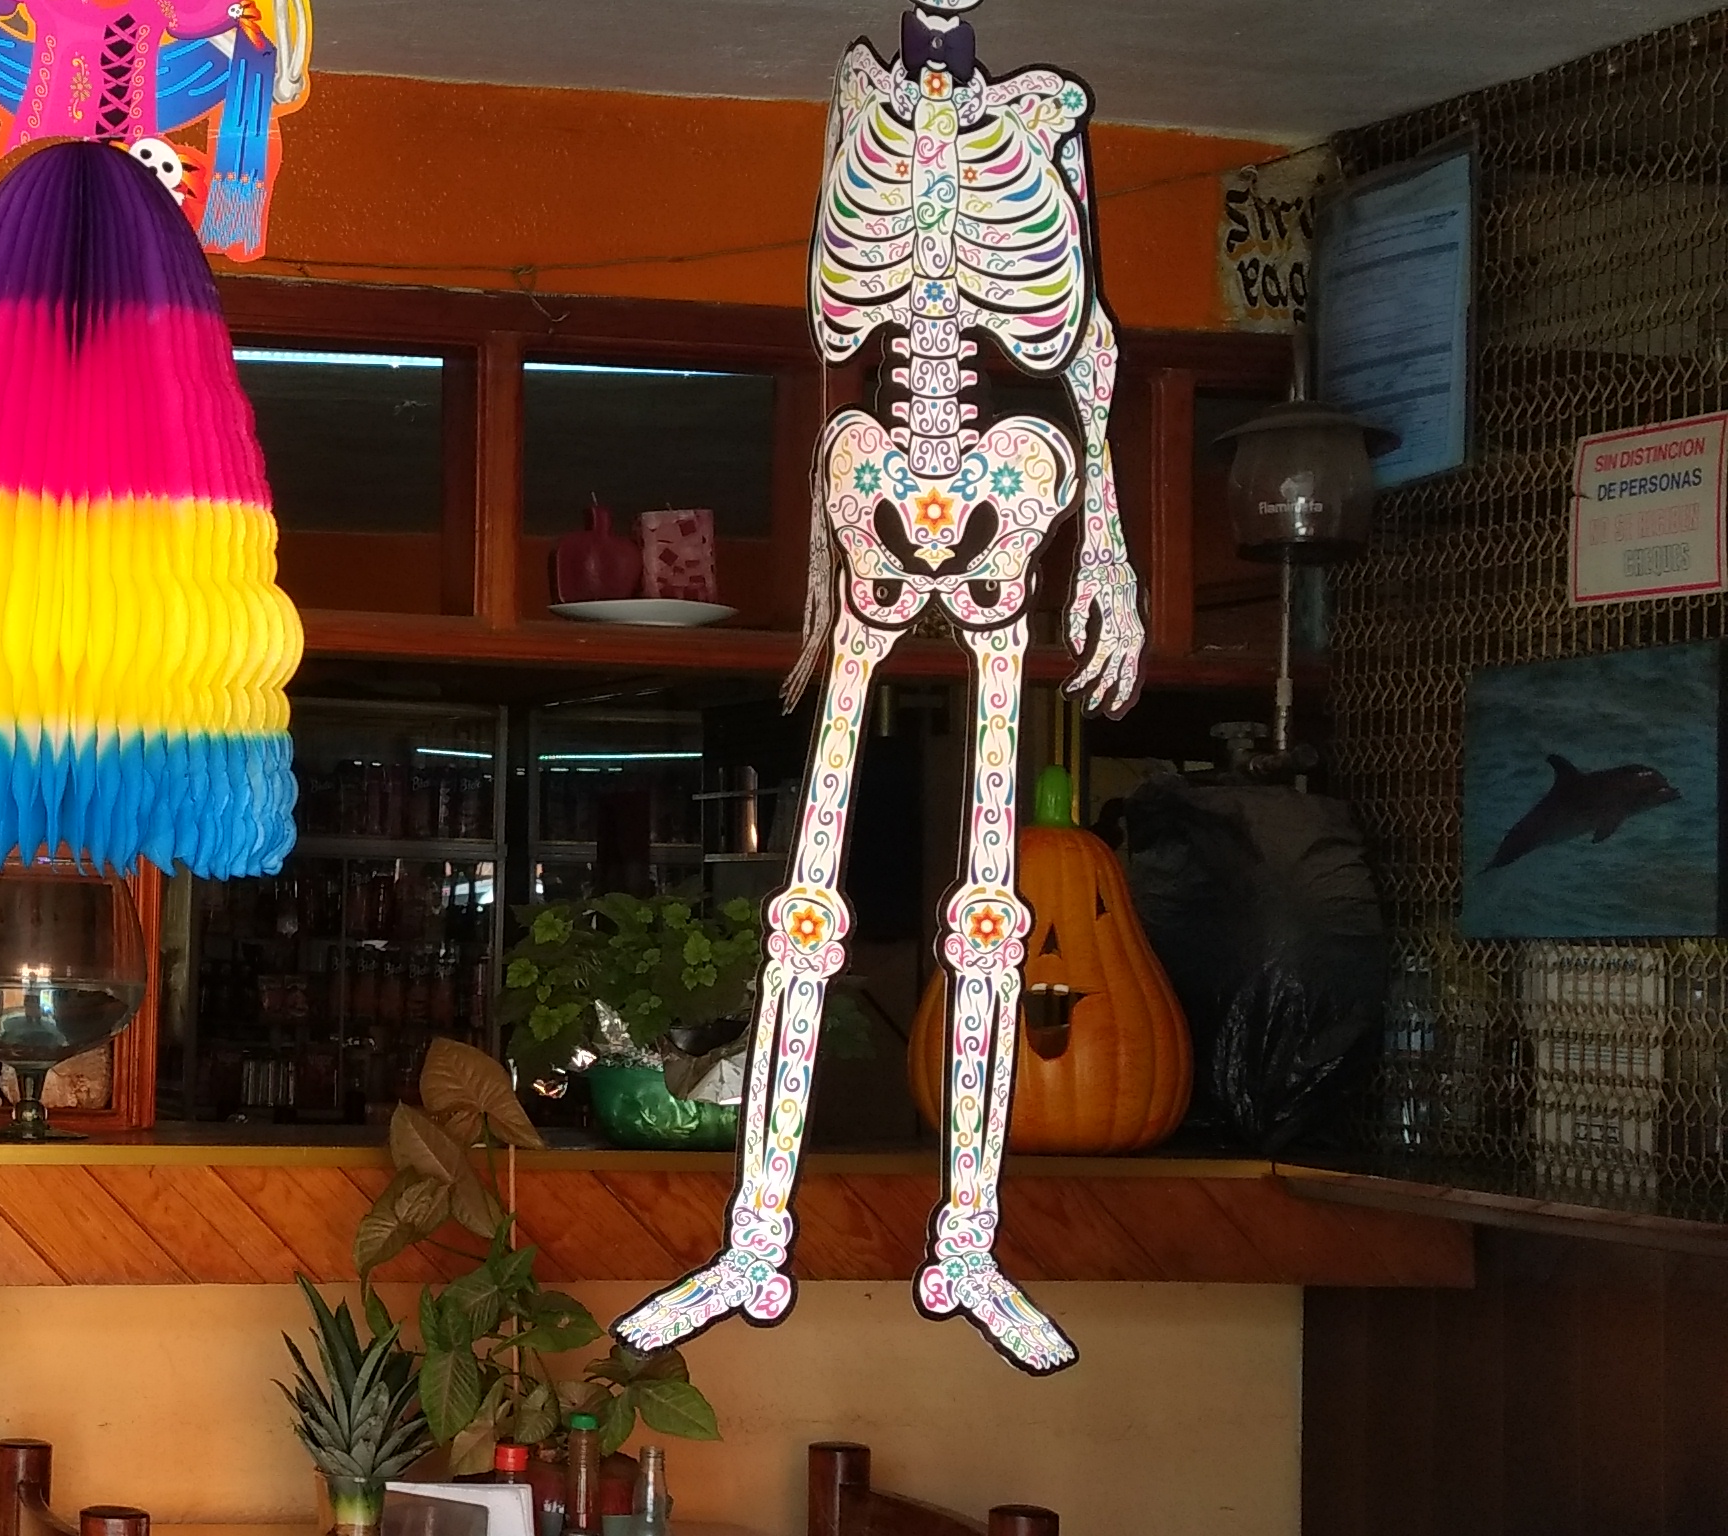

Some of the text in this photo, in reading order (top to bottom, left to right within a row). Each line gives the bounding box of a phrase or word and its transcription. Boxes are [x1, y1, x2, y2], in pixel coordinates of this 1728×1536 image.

[1595, 438, 1706, 473] SIN DISTINCION
[1598, 467, 1702, 502] DE PERSONAS
[1624, 543, 1690, 577] CHEQUES
